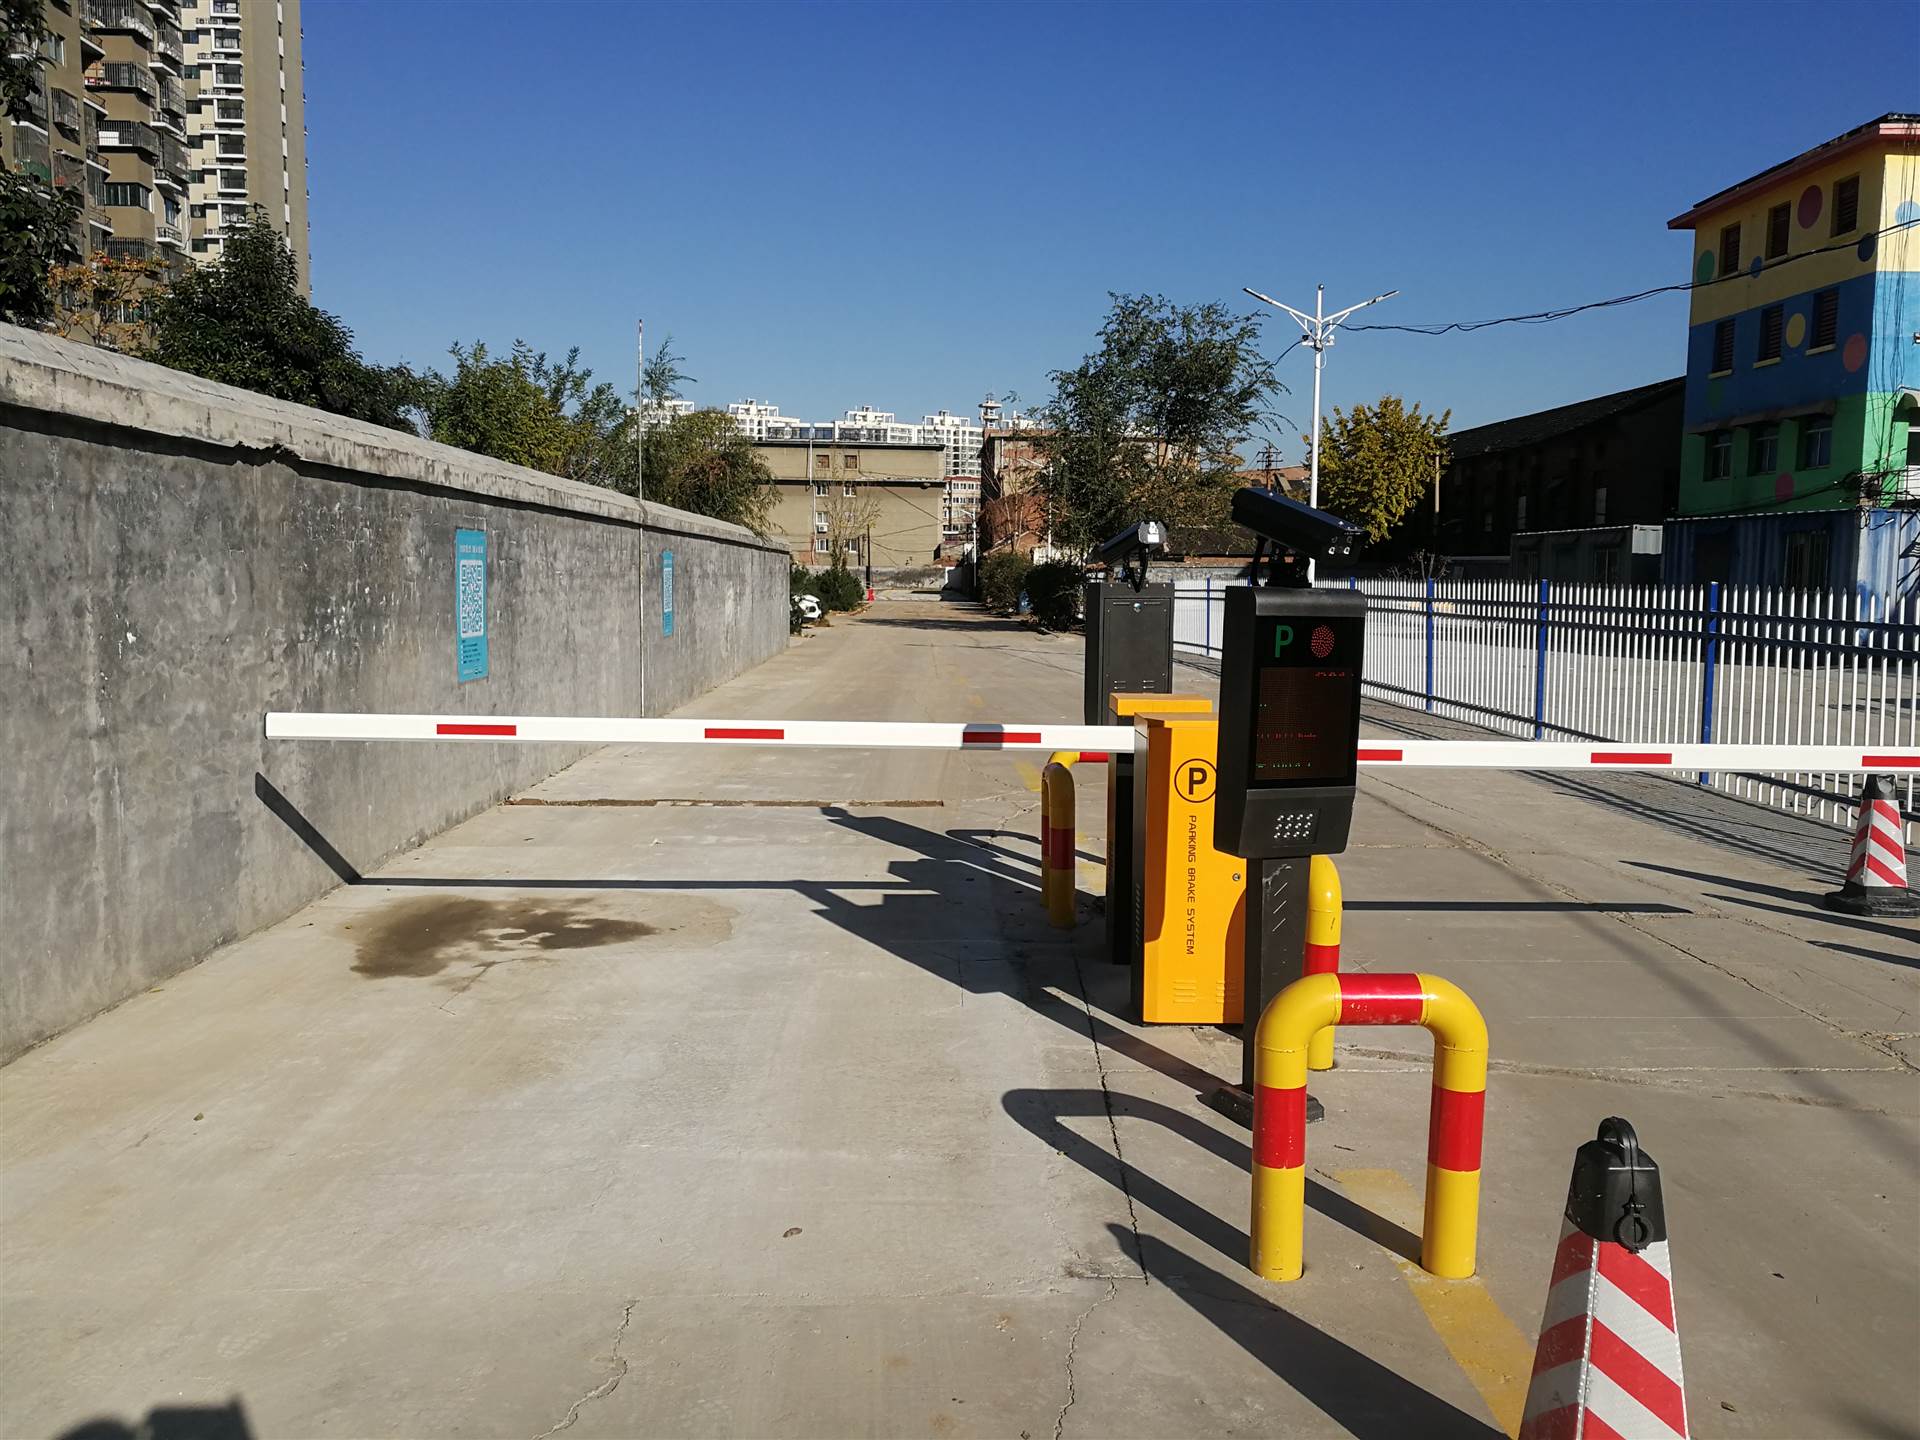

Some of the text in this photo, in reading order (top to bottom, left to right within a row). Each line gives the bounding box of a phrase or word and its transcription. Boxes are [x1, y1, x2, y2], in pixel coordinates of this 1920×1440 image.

[1275, 624, 1294, 658] P
[1188, 767, 1207, 795] P
[1186, 815, 1197, 955] PARKING BRAKE SYSTEM
